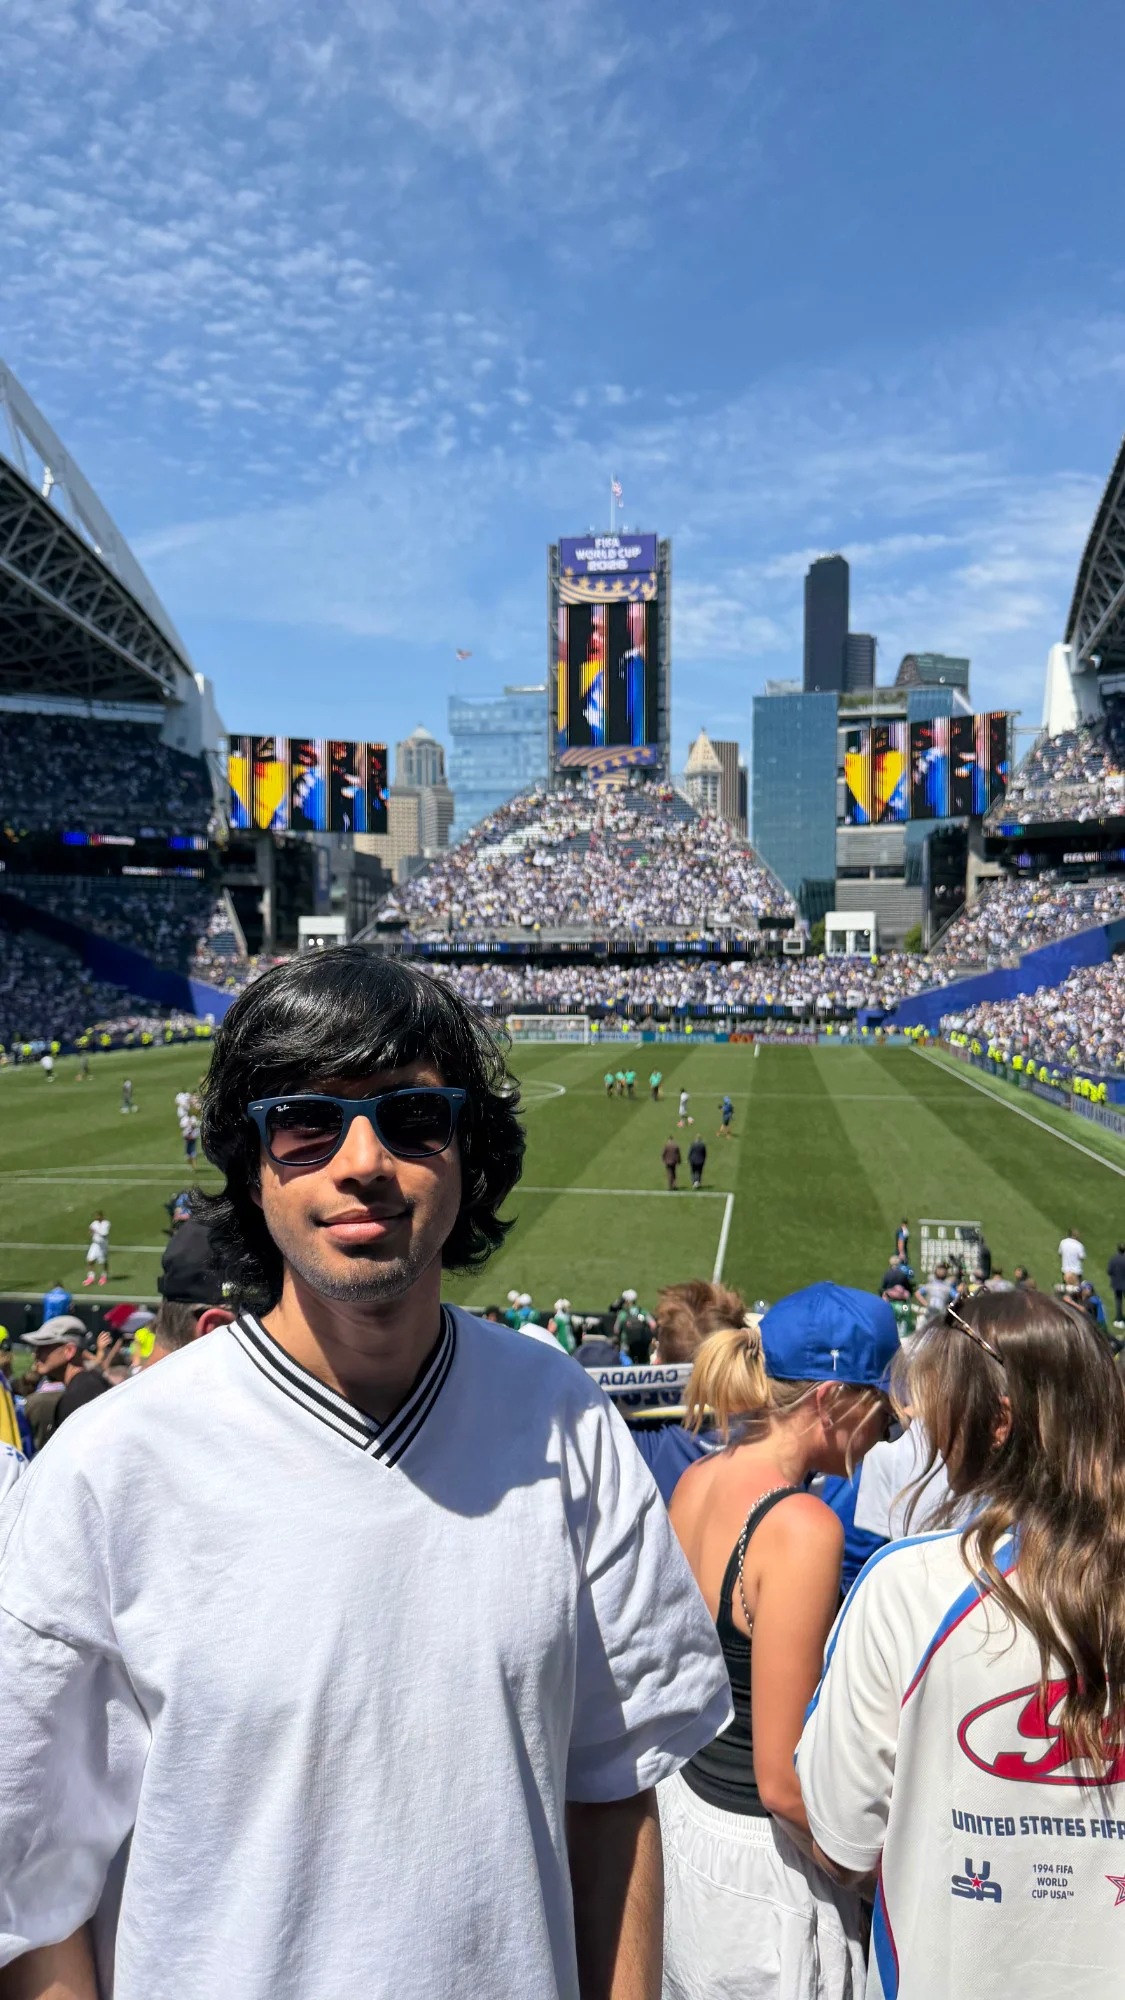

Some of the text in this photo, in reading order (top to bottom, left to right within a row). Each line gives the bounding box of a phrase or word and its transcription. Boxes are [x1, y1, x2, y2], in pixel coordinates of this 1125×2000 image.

[594, 538, 620, 548] FIFA
[575, 546, 642, 560] WORLD CUP
[951, 1808, 1016, 1837] UNITED
[1019, 1815, 1087, 1838] STATES
[1032, 1864, 1074, 1875] 1994 FIFA
[1037, 1877, 1068, 1887] WORLD
[1031, 1889, 1049, 1899] CUP
